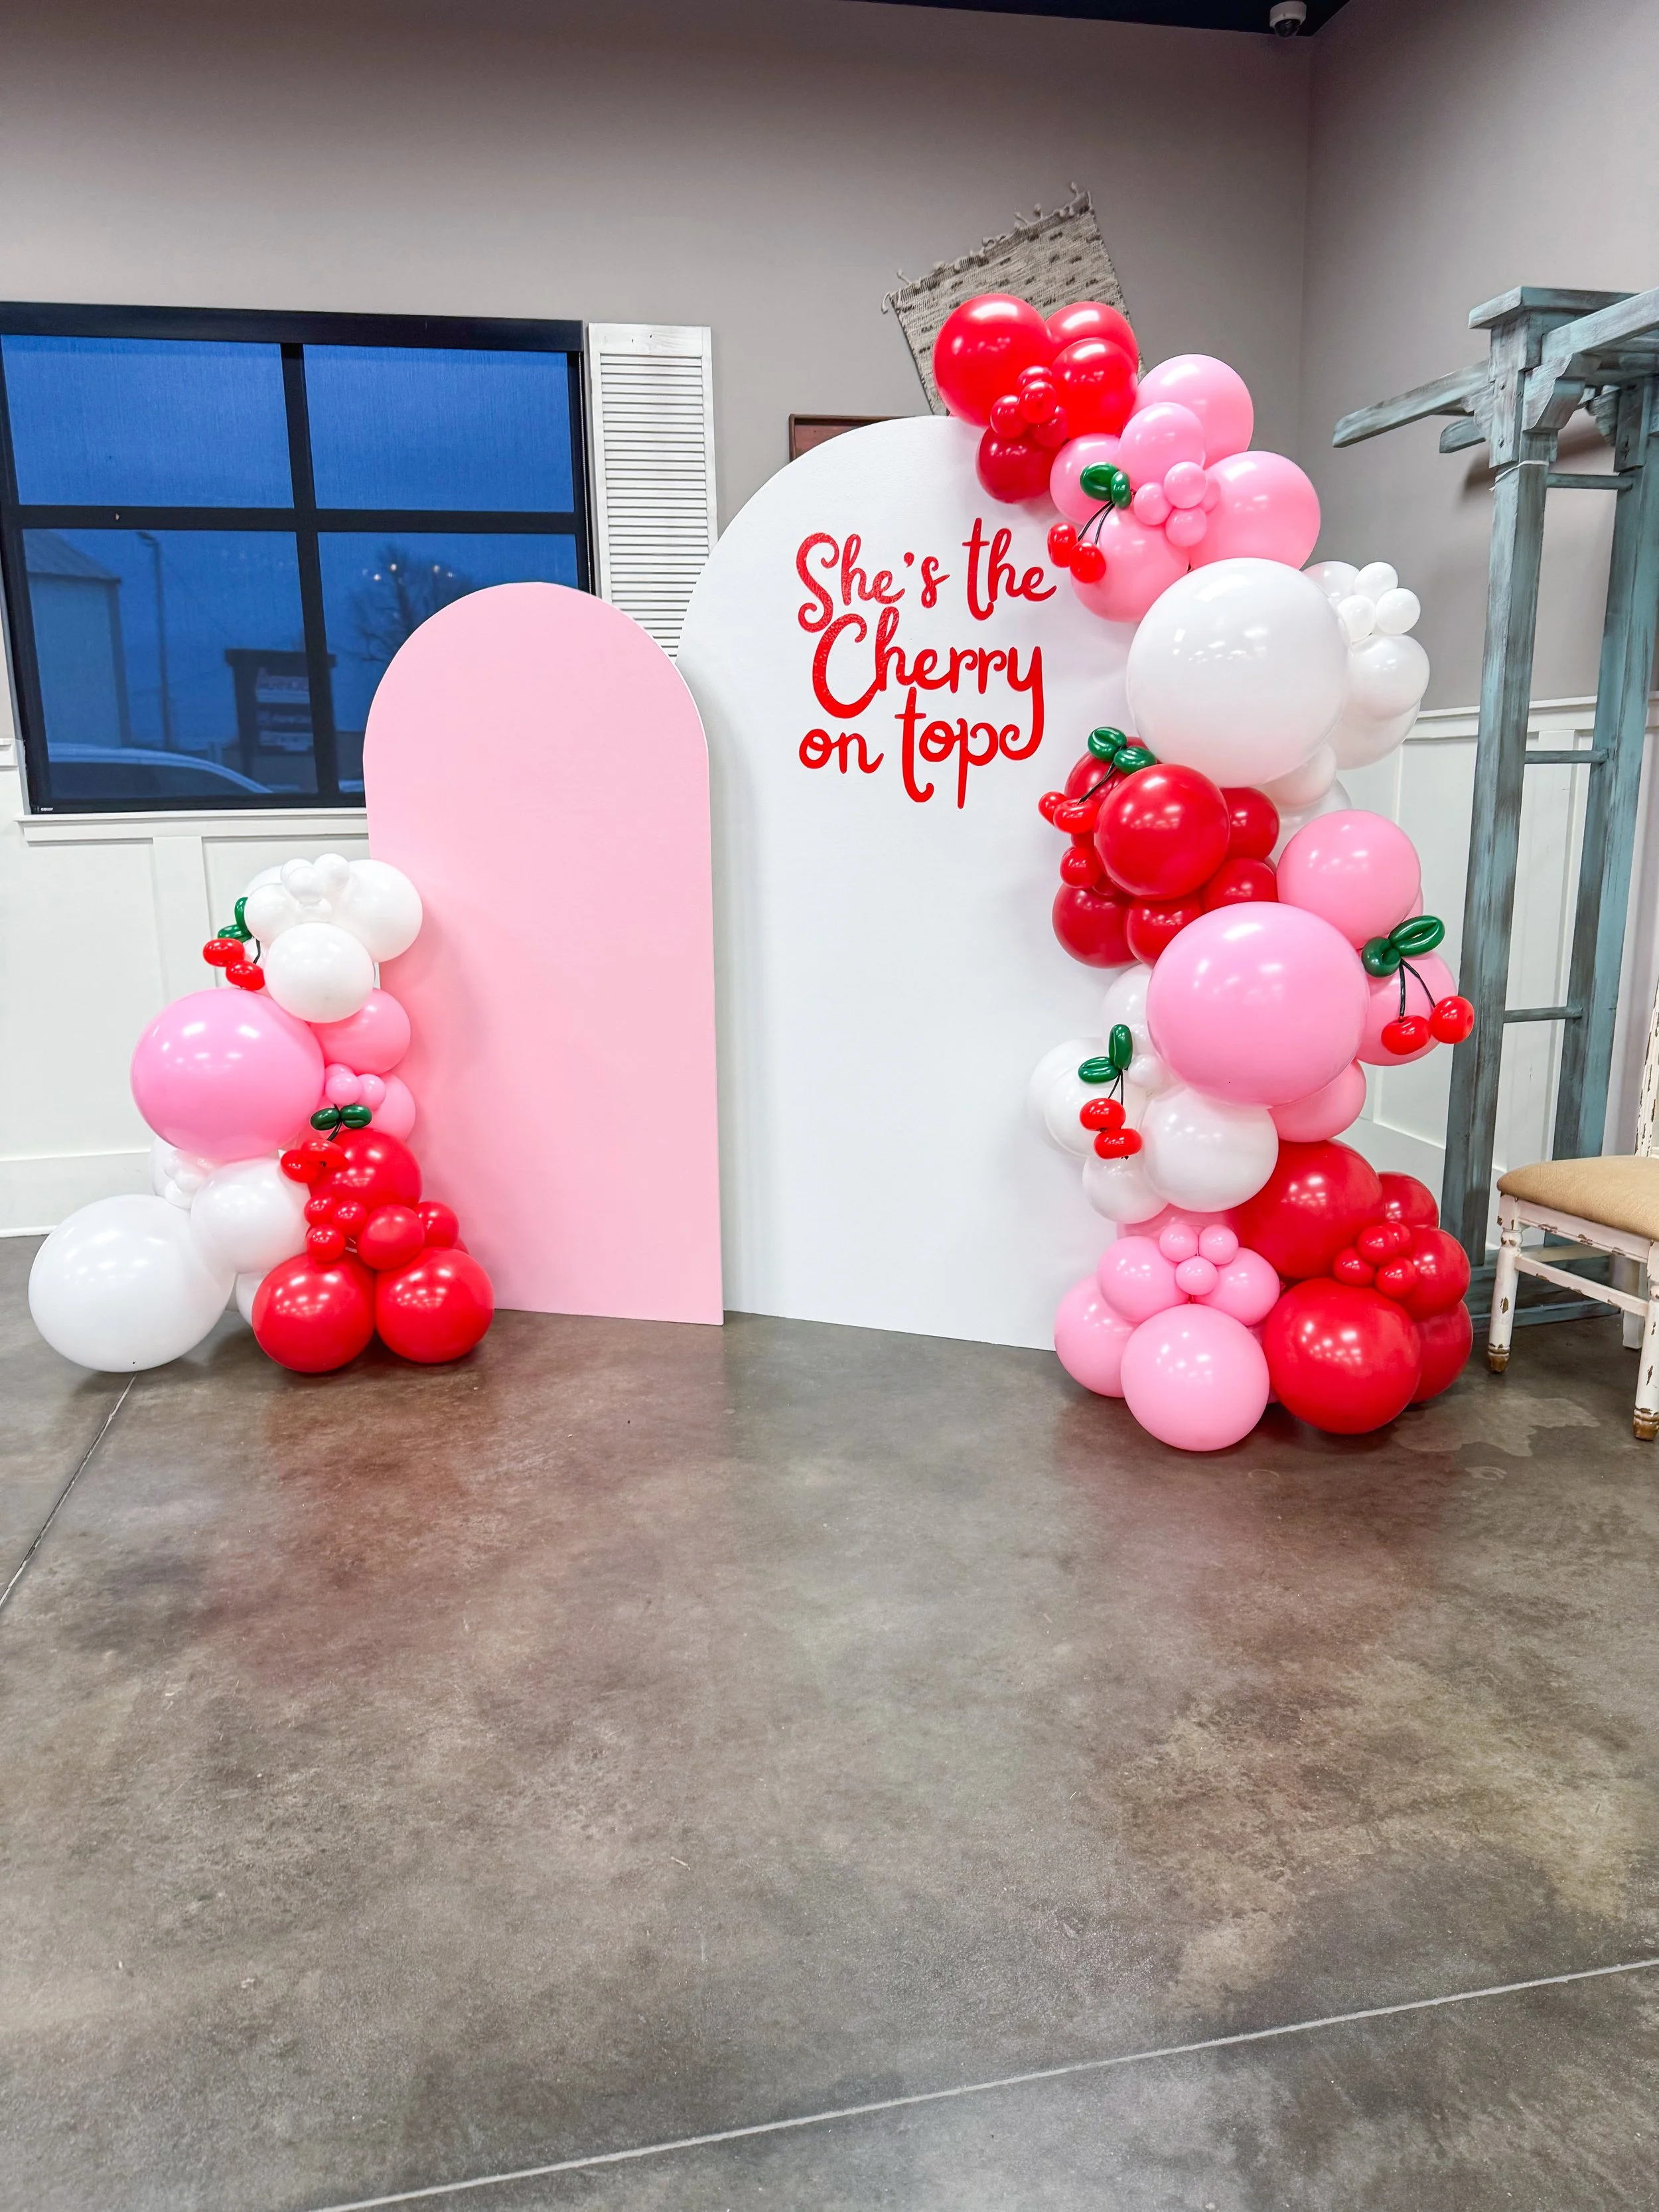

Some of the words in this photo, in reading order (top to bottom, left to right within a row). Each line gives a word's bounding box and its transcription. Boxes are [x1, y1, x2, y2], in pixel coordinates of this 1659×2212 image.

[796, 532, 950, 633] She's
[962, 517, 1057, 621] the
[812, 606, 1045, 761] Cherry
[798, 728, 884, 774] on
[894, 686, 999, 810] top
